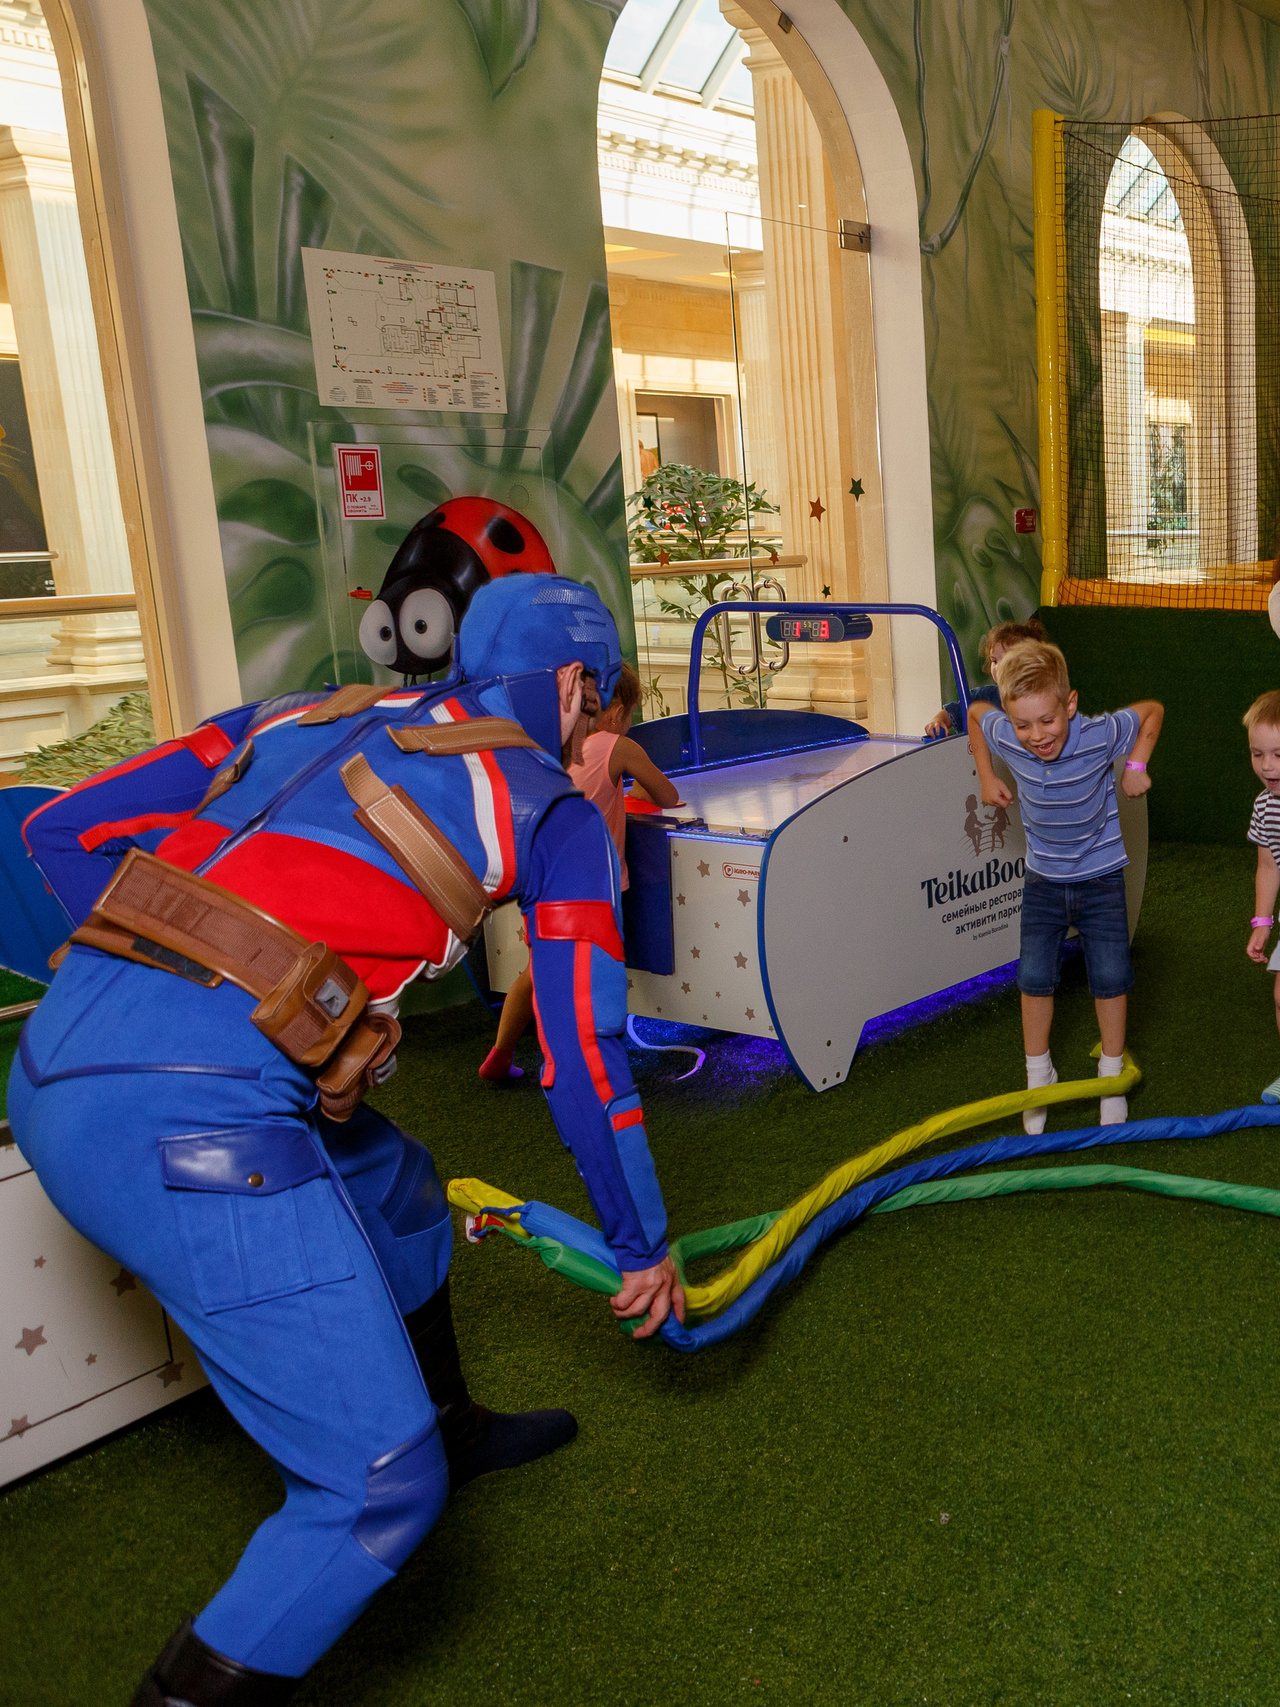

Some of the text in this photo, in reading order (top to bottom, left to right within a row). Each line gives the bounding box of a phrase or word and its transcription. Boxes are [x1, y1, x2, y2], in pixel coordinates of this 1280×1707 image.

[346, 493, 359, 503] ПК
[942, 903, 988, 924] семейные
[955, 912, 997, 935] активити
